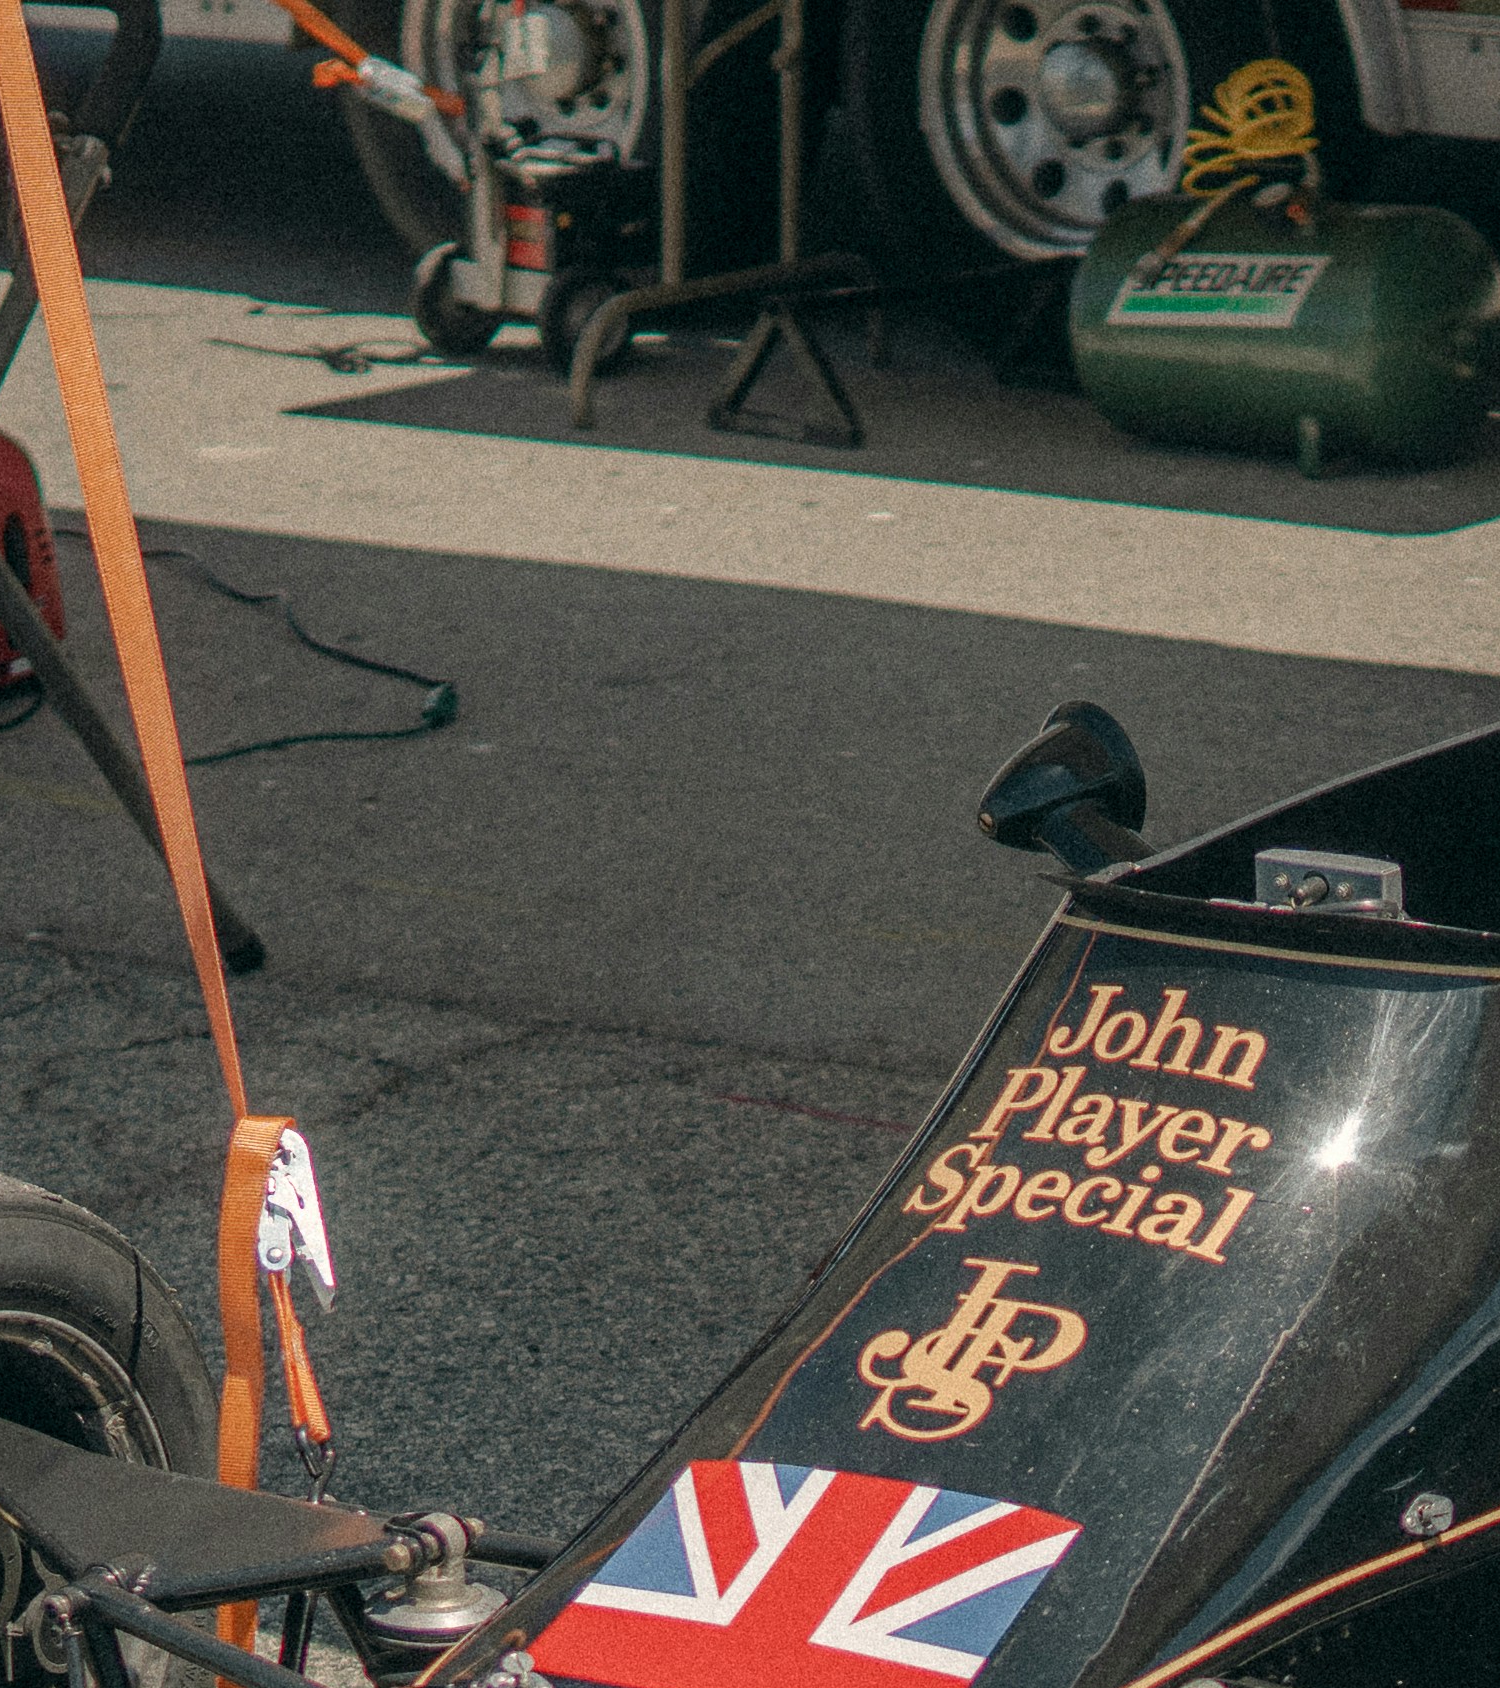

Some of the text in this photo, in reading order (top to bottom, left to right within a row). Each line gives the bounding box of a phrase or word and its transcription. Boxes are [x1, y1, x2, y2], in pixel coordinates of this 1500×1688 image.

[1049, 983, 1269, 1091] John
[967, 1066, 1273, 1178] Player
[903, 1140, 1258, 1266] Special
